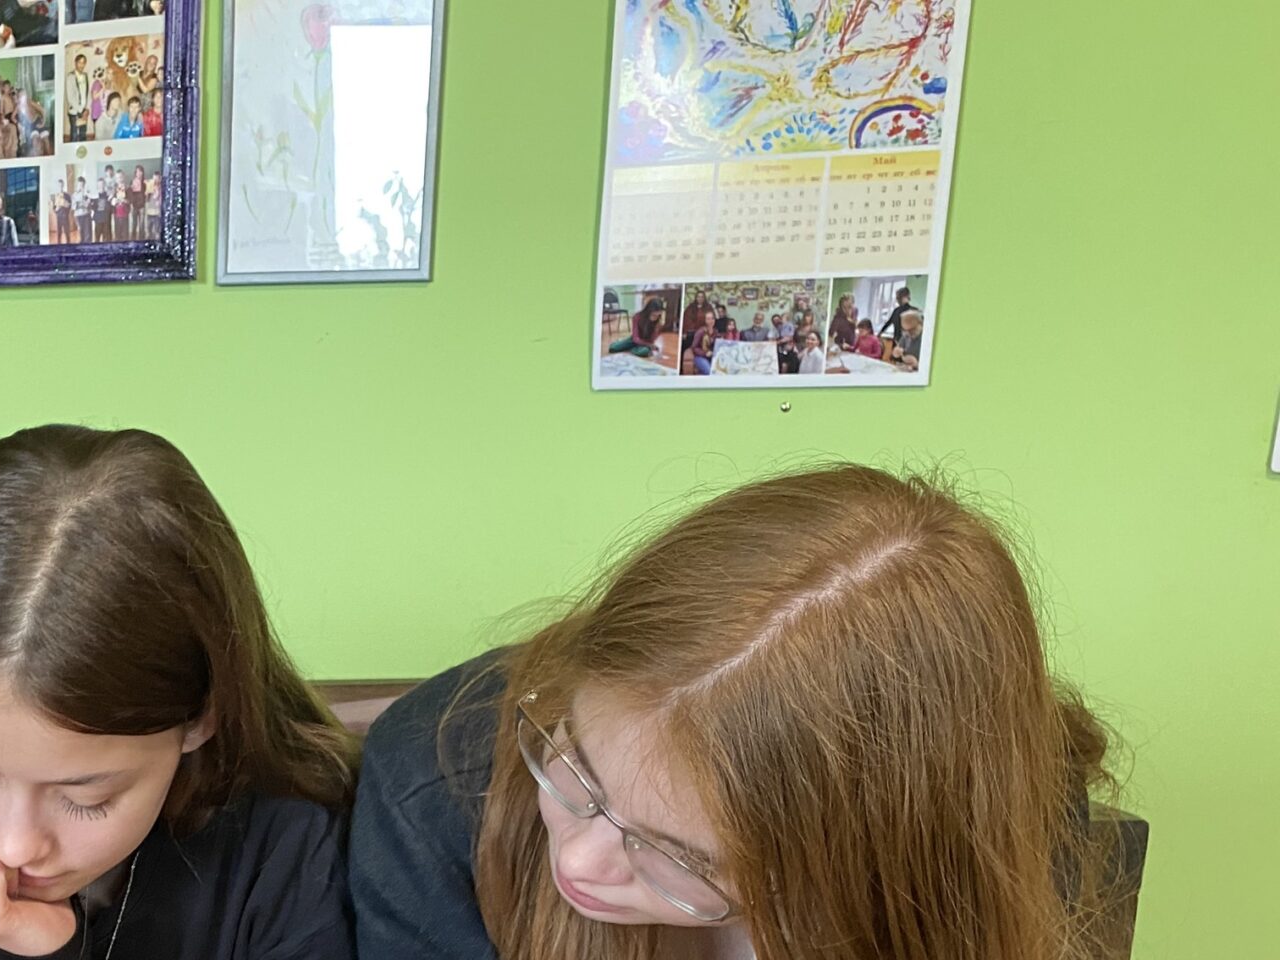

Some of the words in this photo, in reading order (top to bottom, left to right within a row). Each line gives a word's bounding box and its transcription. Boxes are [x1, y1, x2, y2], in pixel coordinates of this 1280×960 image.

[872, 155, 897, 165] Май
[866, 186, 871, 194] 1
[881, 185, 887, 193] 2
[897, 184, 903, 192] 3
[913, 184, 919, 192] 4
[880, 200, 886, 208] 9
[892, 199, 901, 208] 10
[908, 199, 916, 207] 11
[923, 198, 933, 207] 12
[828, 217, 838, 225] 13
[859, 216, 868, 224] 15
[874, 215, 884, 223] 16
[890, 214, 899, 222] 17
[905, 214, 915, 222] 18
[922, 213, 932, 221] 19
[841, 232, 850, 240] 21
[856, 231, 867, 239] 22
[872, 230, 882, 238] 23
[887, 230, 897, 238] 24
[903, 229, 913, 237] 25
[824, 247, 834, 255] 27
[855, 246, 865, 254] 29
[886, 244, 895, 252] 31
